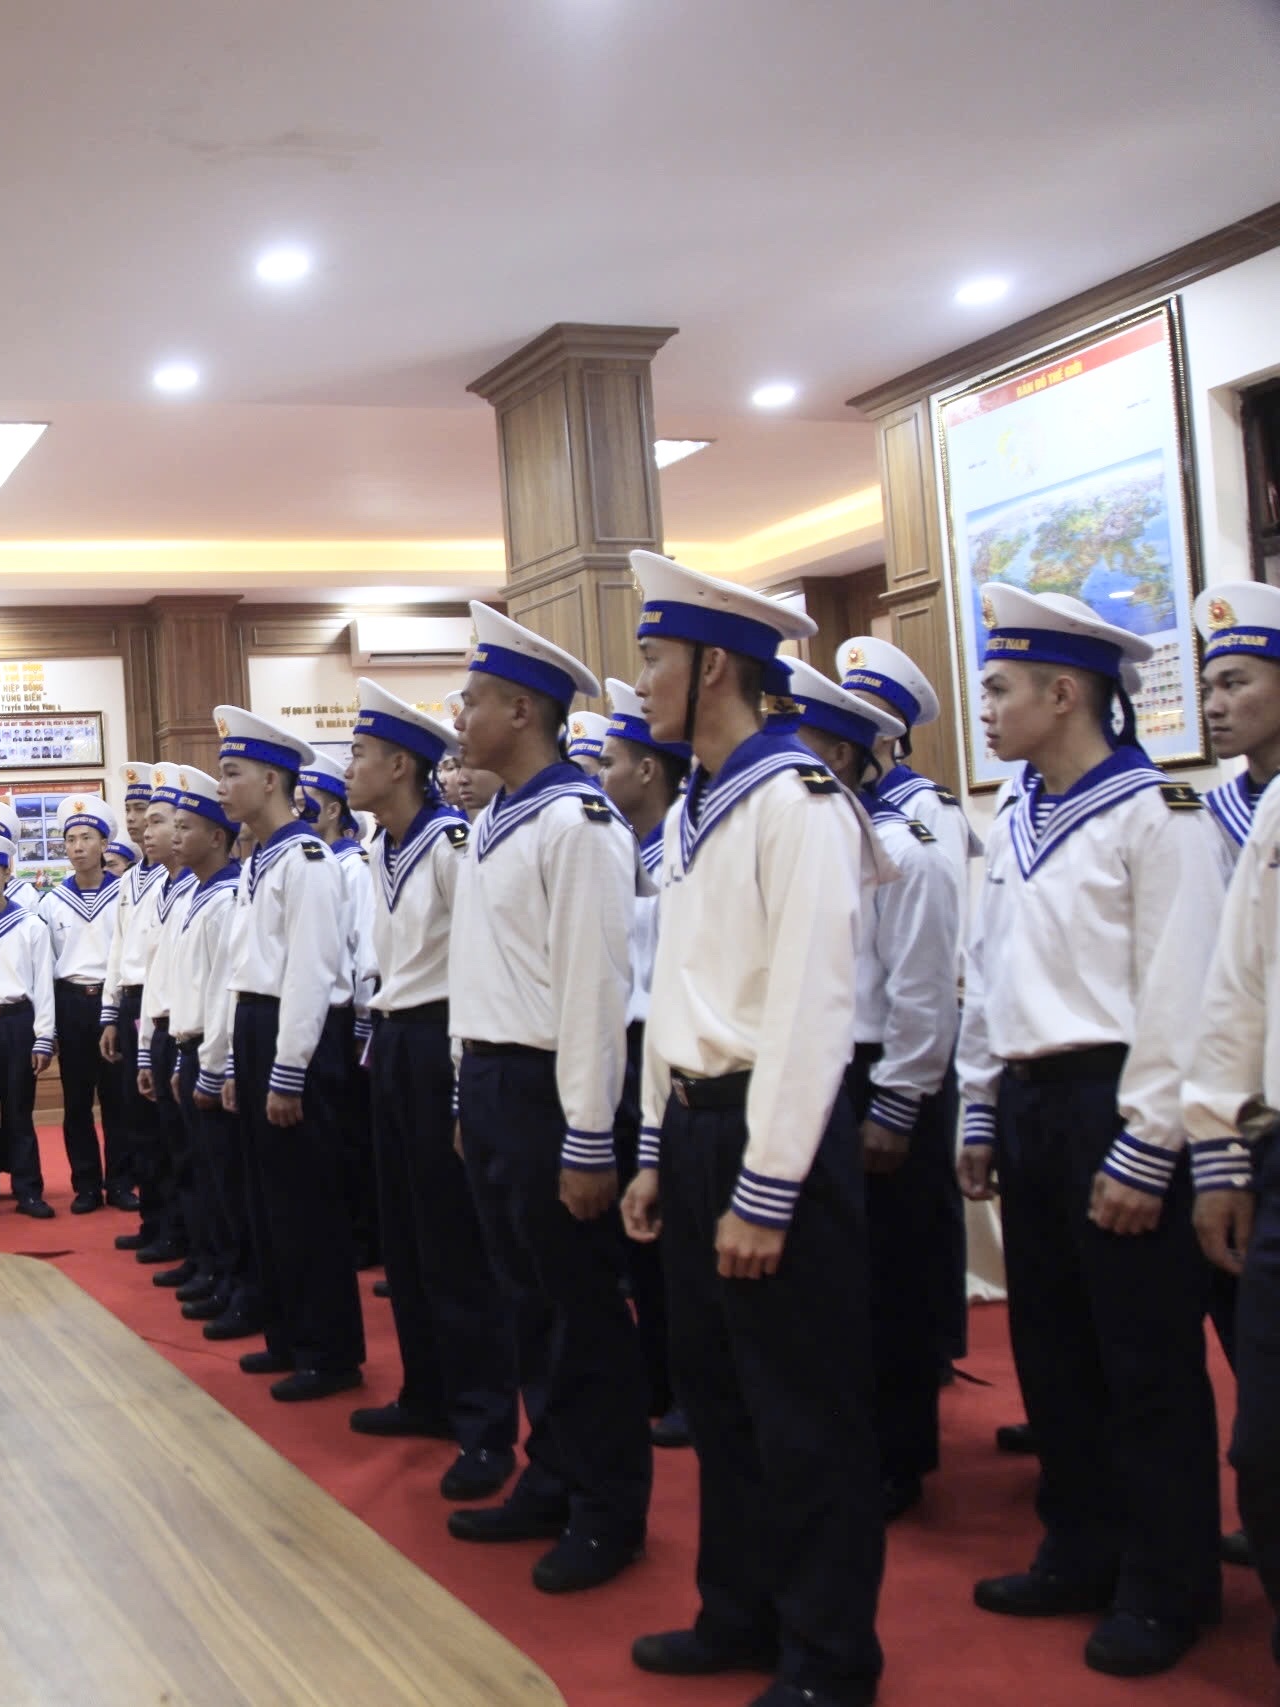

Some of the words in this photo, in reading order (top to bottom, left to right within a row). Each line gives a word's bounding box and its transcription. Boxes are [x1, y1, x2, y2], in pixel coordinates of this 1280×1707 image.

[1016, 379, 1034, 398] BẢN
[1035, 373, 1047, 390] ĐỒ
[1048, 364, 1064, 384] THẾ
[3, 683, 20, 693] HIỆP
[1, 693, 21, 702] VÙNG
[292, 706, 312, 715] QUAN
[314, 704, 328, 714] TÂM
[330, 702, 344, 714] CỦA
[326, 718, 347, 728] NHÂN
